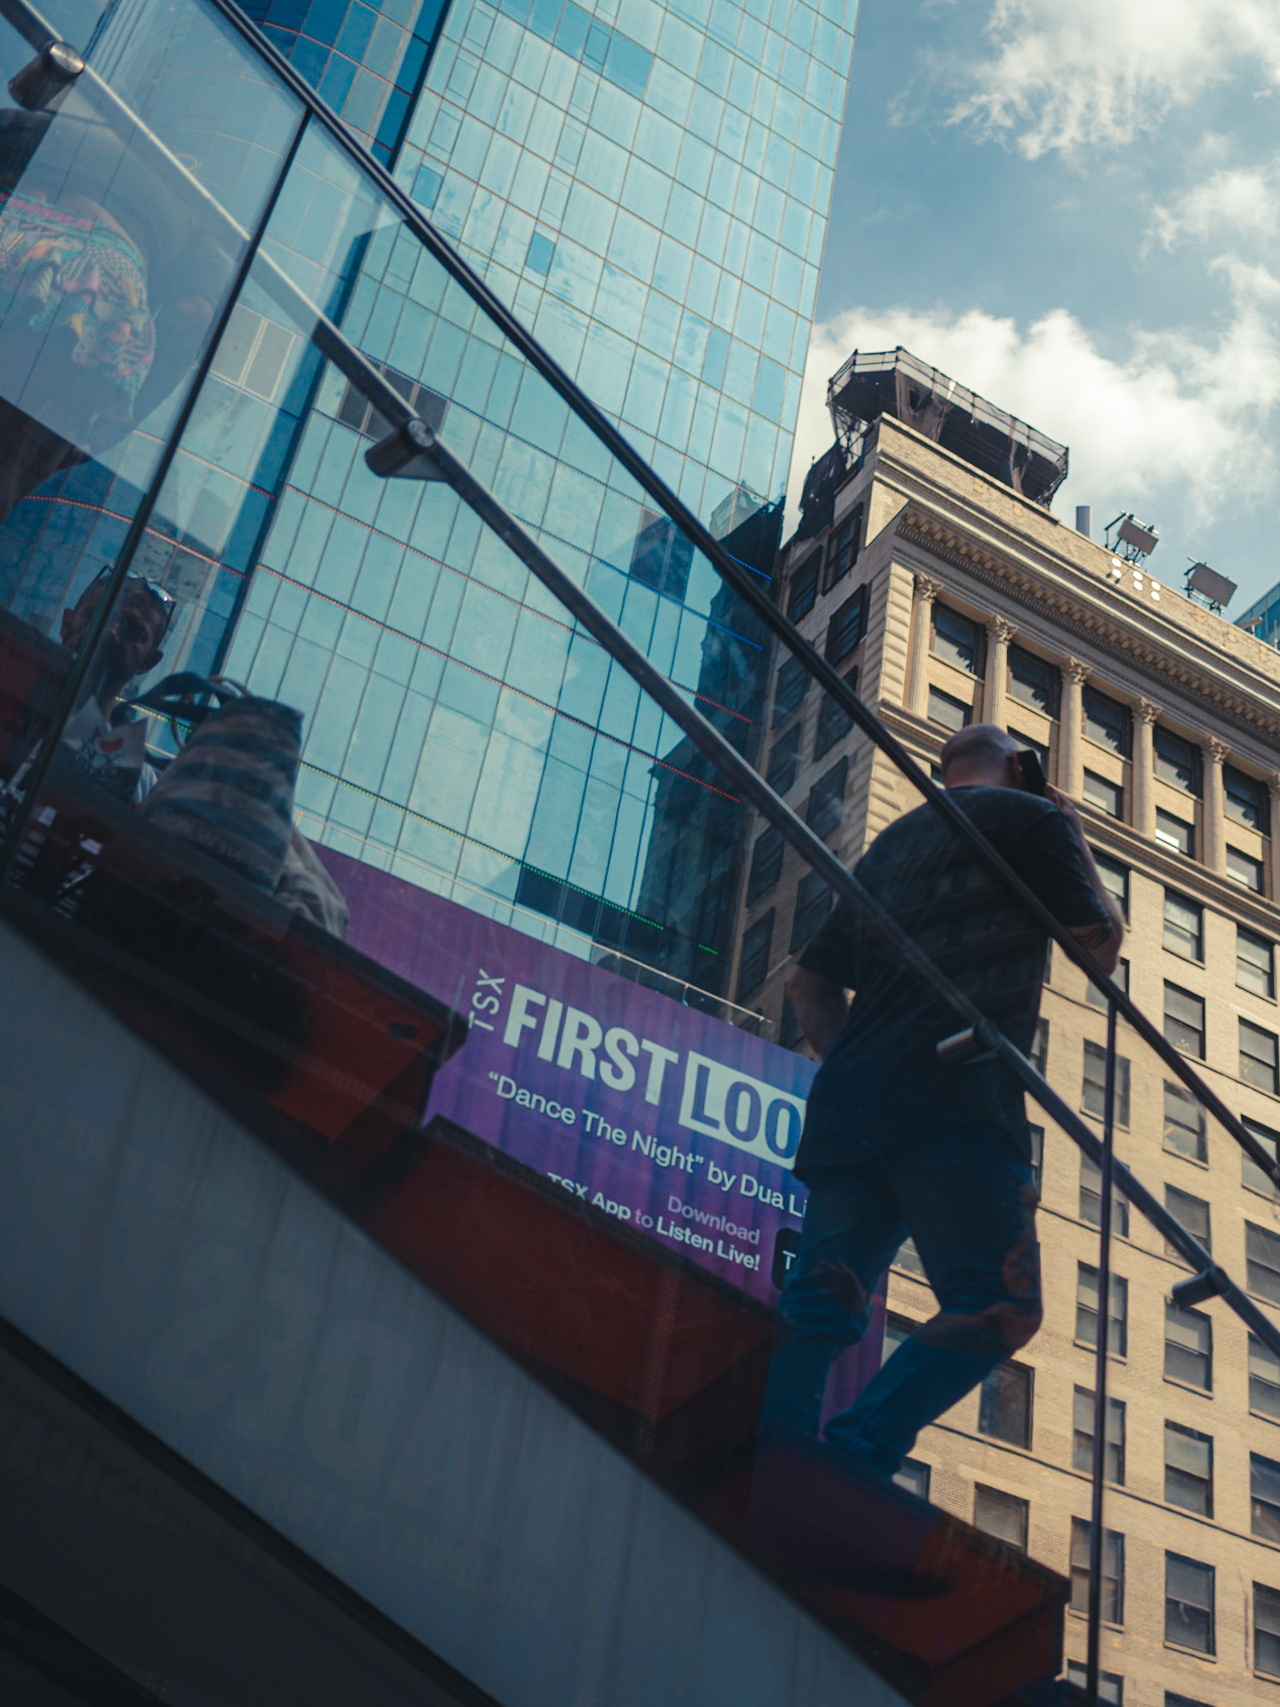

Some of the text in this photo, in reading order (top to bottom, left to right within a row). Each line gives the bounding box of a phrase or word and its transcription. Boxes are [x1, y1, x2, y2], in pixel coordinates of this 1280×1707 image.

[468, 968, 506, 1032] TSX
[502, 982, 802, 1160] FIRST LOO
[581, 1109, 628, 1146] The
[707, 1161, 737, 1193] by
[740, 1173, 785, 1210] Dua
[788, 1194, 808, 1219] Li
[591, 1191, 632, 1220] App
[634, 1208, 654, 1229] to
[656, 1215, 714, 1254] Listen
[716, 1239, 761, 1272] Live!
[667, 1195, 761, 1246] Download
